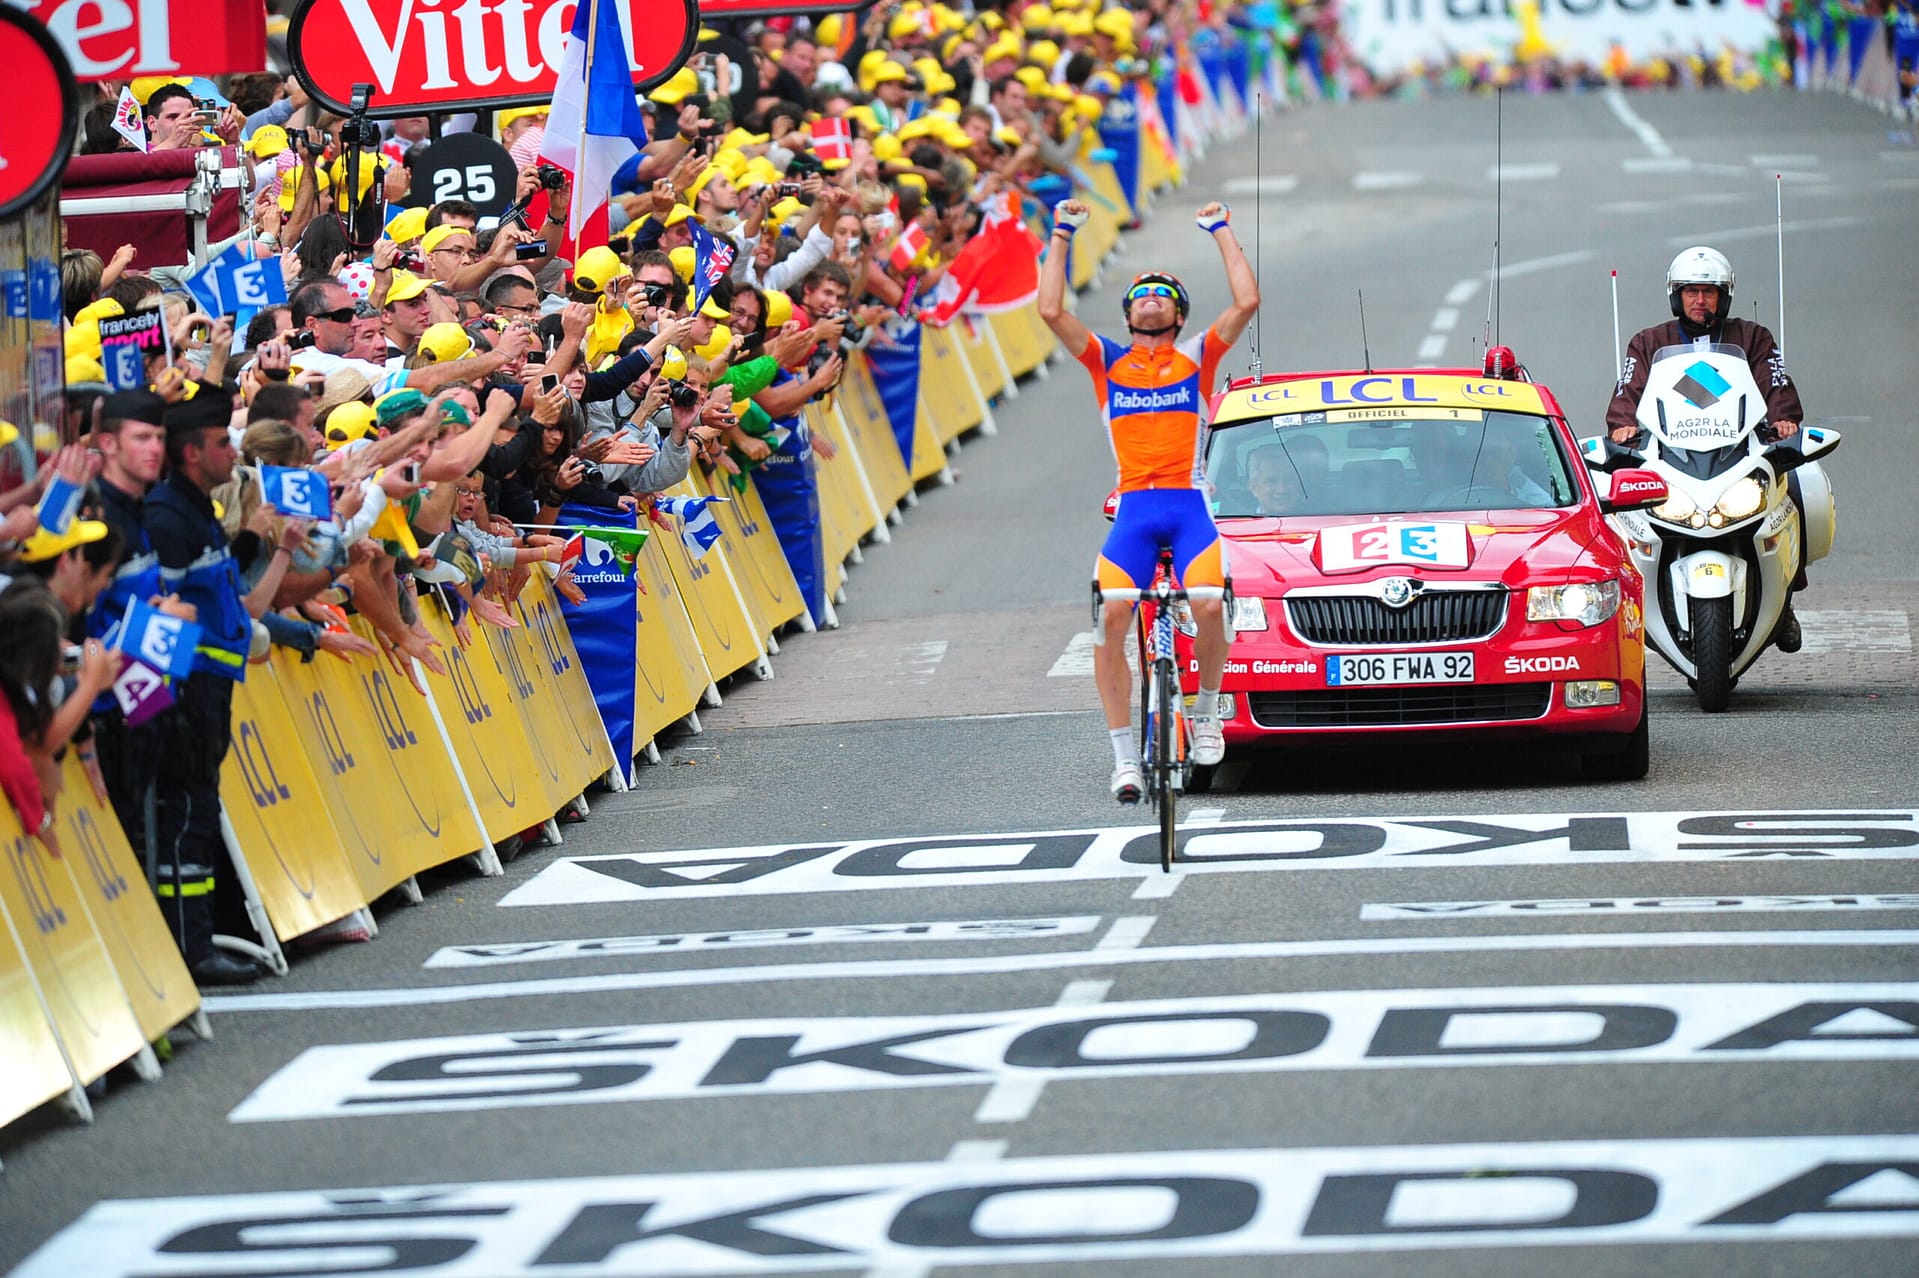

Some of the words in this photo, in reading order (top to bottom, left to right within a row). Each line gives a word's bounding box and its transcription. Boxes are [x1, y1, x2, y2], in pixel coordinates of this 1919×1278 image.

[432, 164, 496, 206] 25
[1113, 386, 1191, 409] Rabobank
[1251, 389, 1298, 404] LCL
[1320, 377, 1438, 405] LCL
[1465, 383, 1513, 397] LCL
[1347, 409, 1408, 420] OFFICIEL
[1676, 417, 1711, 429] AG2R
[1714, 418, 1730, 428] LA
[1670, 427, 1737, 441] MONDIALE
[1619, 481, 1665, 493] ŠKODA
[1360, 532, 1388, 558] 2
[1408, 531, 1438, 556] 3
[1252, 660, 1317, 674] Générale
[1342, 658, 1386, 682] 306
[1392, 657, 1436, 680] FWA
[1443, 655, 1472, 679] 92
[1504, 655, 1581, 674] ŠKODA
[361, 668, 418, 751] LCL
[338, 1000, 1919, 1106] ŠKODA
